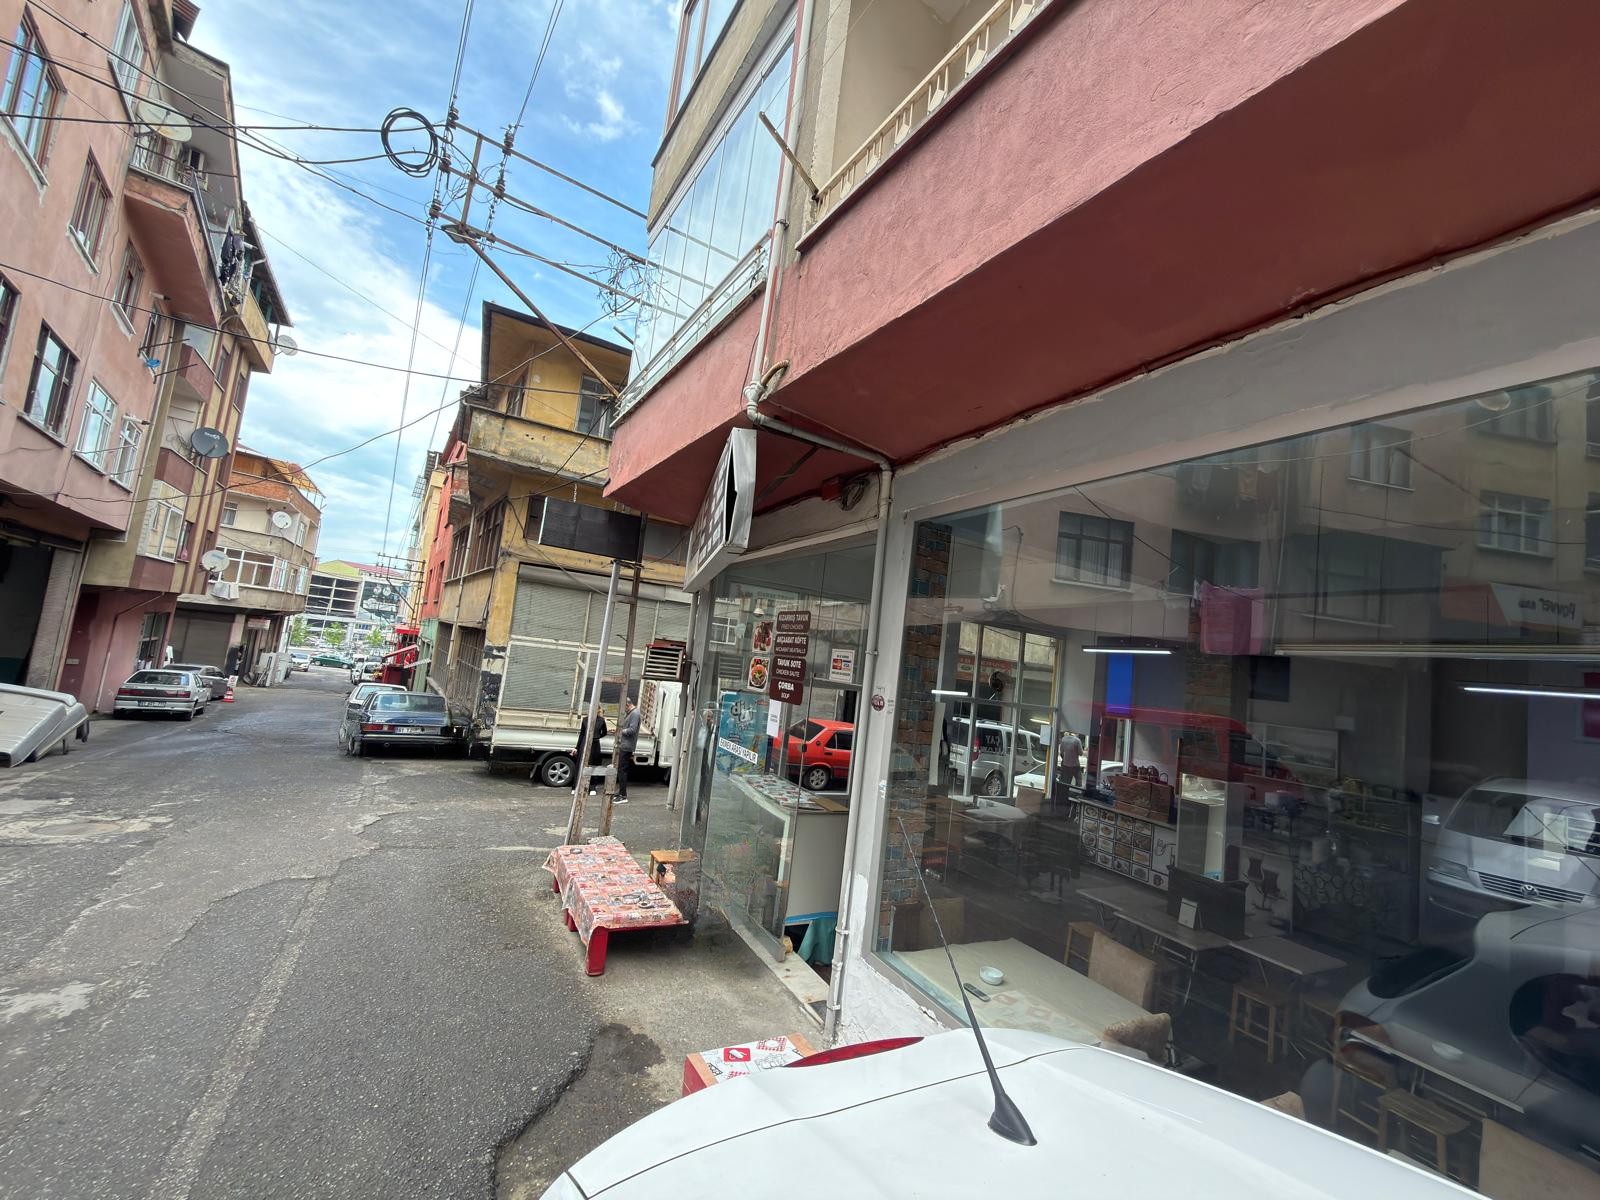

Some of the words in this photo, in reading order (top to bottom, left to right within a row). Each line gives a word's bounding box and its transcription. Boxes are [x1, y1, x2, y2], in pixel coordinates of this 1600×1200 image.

[795, 636, 807, 645] KÖFTE
[777, 658, 790, 667] TAVUK
[790, 660, 802, 669] SOTE
[778, 681, 795, 691] ÇORBA
[781, 692, 790, 700] SOUP
